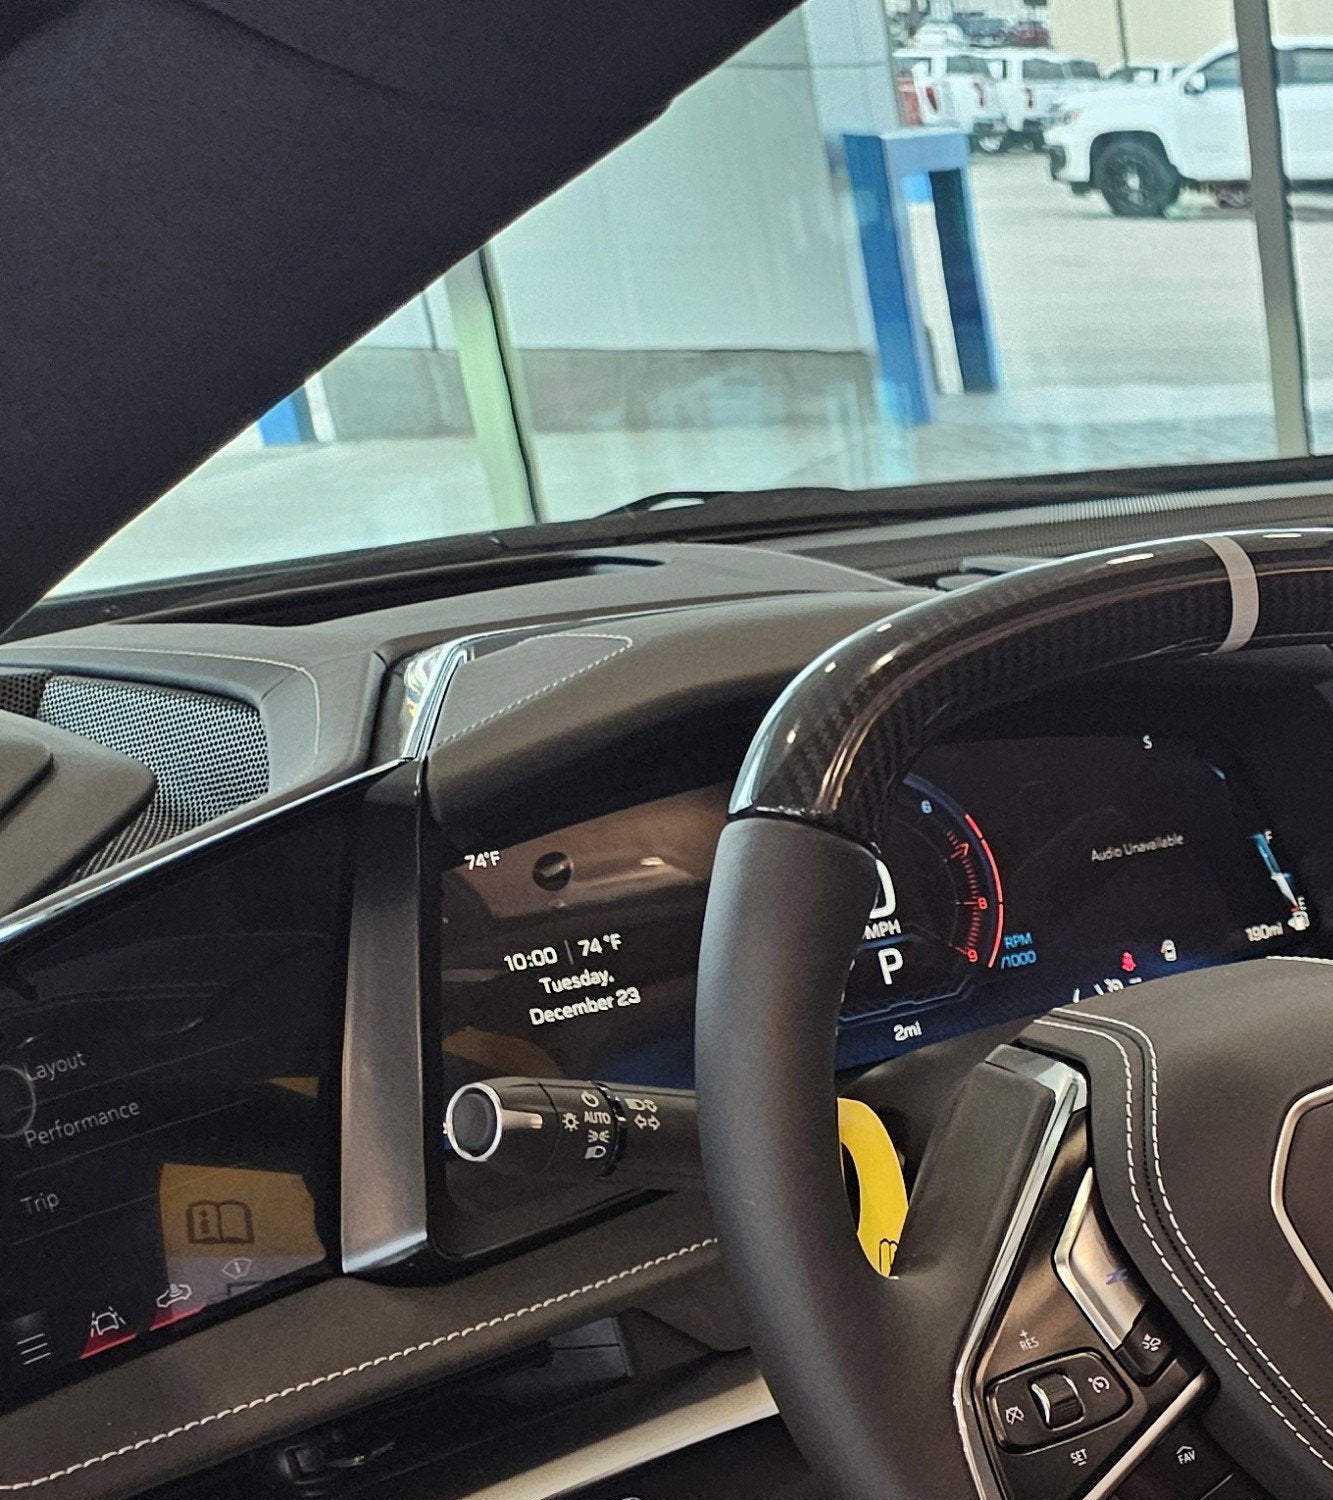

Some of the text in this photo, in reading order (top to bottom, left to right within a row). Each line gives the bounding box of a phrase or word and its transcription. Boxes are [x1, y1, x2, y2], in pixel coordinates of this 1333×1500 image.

[1143, 734, 1153, 750] S
[920, 800, 932, 814] 6
[1091, 832, 1184, 862] Audio Unavailable
[1264, 829, 1273, 845] F
[463, 850, 500, 871] 74°F
[978, 897, 988, 910] 8
[863, 918, 901, 940] MPH
[1004, 932, 1033, 950] RPM
[503, 946, 558, 972] 10:00
[877, 947, 904, 985] P
[966, 949, 979, 963] 9
[1001, 949, 1037, 969] /1000
[528, 986, 641, 1026] December 23
[893, 1020, 922, 1042] 2mi
[25, 1050, 87, 1083] Layout
[24, 1100, 141, 1150] Performance
[583, 1111, 612, 1125] AUTO
[20, 1190, 60, 1217] Trip
[1019, 1336, 1041, 1351] RES
[1070, 1448, 1088, 1464] SET
[1177, 1450, 1196, 1465] FAV
